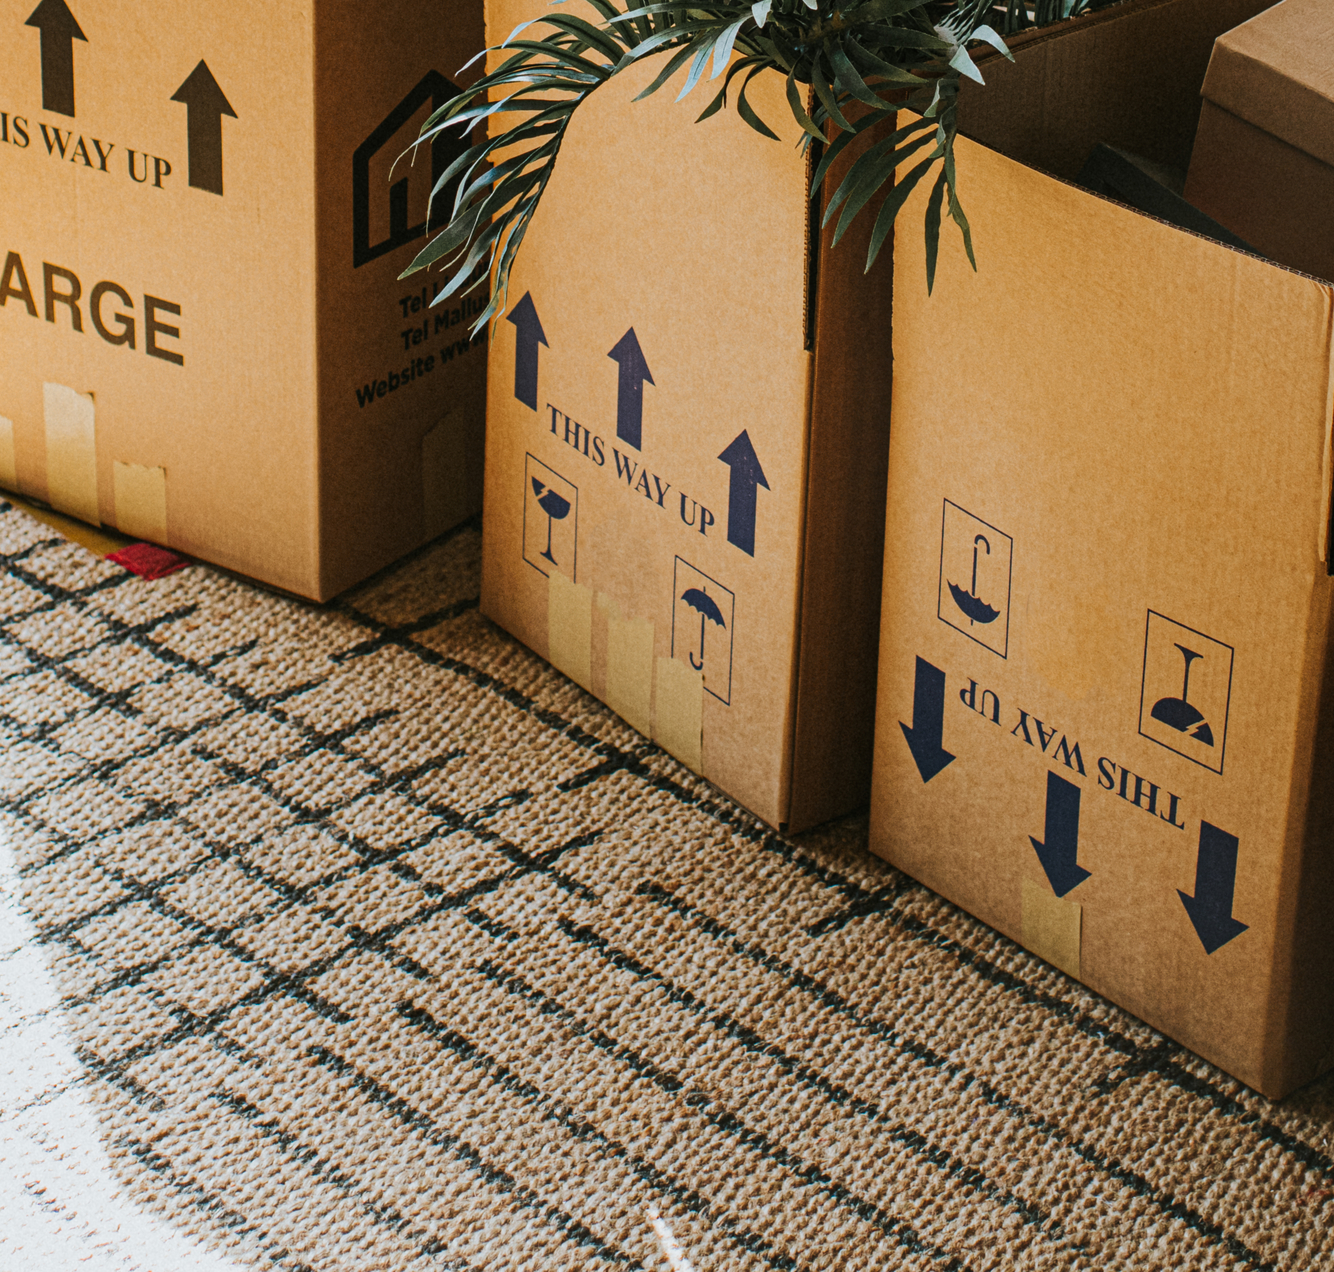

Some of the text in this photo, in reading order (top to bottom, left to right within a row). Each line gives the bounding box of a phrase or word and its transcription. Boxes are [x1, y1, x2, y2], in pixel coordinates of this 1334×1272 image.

[38, 123, 115, 175] WAY
[126, 151, 172, 190] UP
[399, 287, 427, 319] Tel
[401, 319, 428, 350] Tel
[355, 355, 435, 409] Website
[547, 403, 715, 538] THIS WAY UP
[960, 677, 1185, 830] THIS WAY UP
